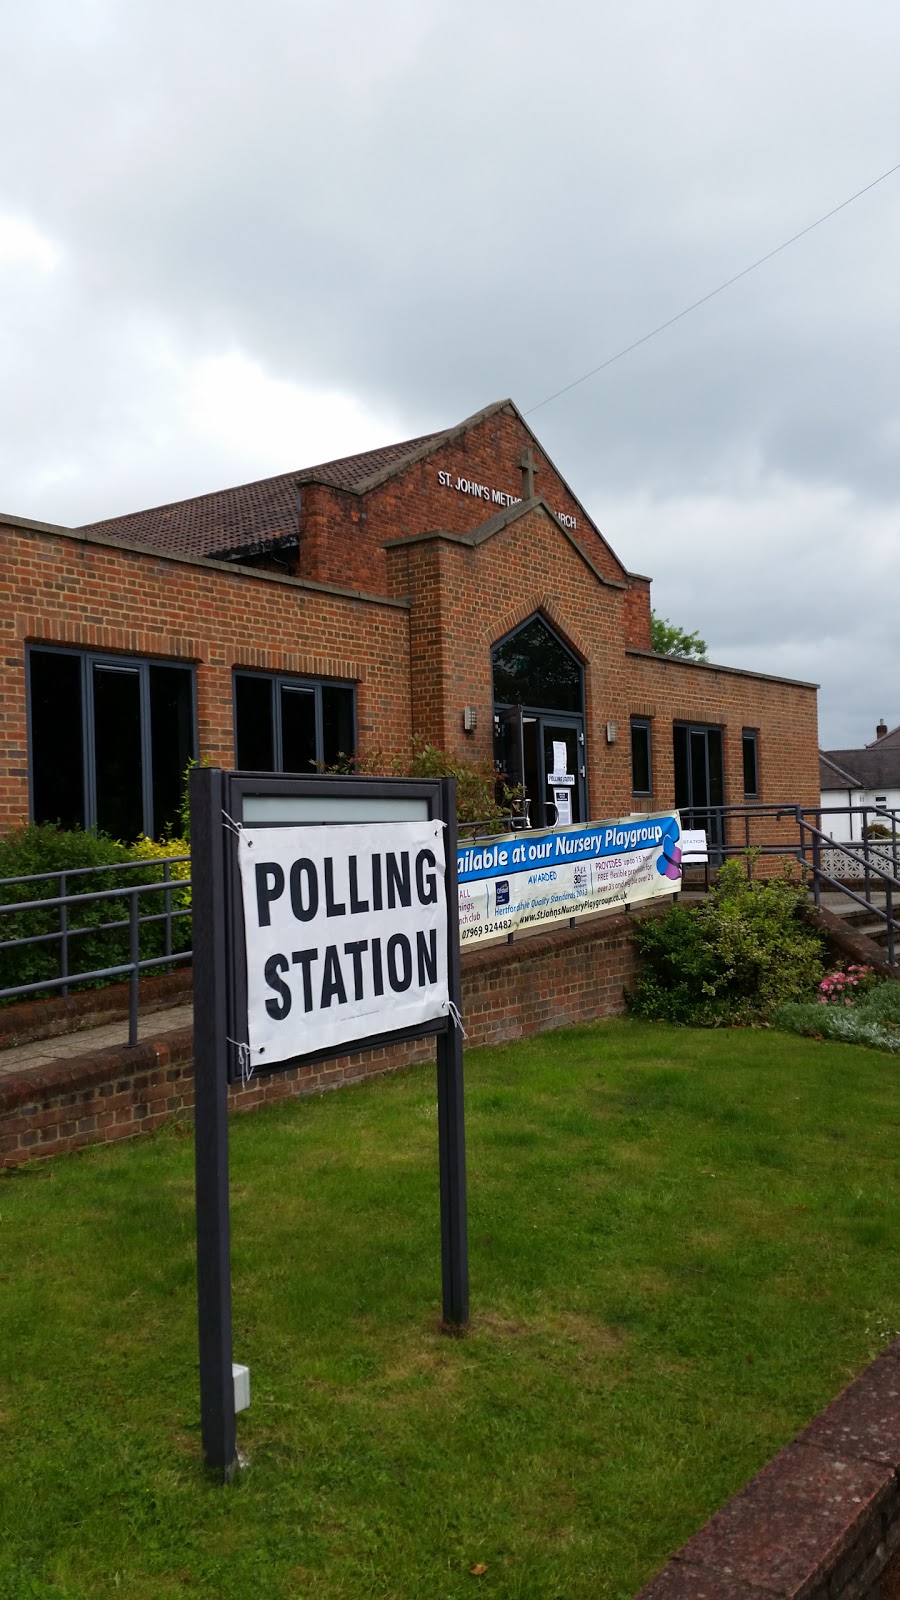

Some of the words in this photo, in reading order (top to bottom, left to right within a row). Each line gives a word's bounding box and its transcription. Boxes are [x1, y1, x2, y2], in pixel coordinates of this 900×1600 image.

[438, 470, 453, 488] ST.
[455, 477, 490, 500] JOHN'S
[512, 844, 526, 864] at
[528, 842, 552, 861] our
[555, 835, 602, 855] Nursery
[605, 825, 663, 850] Playgroup
[595, 858, 622, 871] PROVIDES
[527, 870, 557, 884] AWARDED
[598, 873, 609, 882] FREE
[255, 849, 438, 928] POLLING
[460, 889, 470, 899] ALL
[576, 888, 588, 898] 2013
[461, 925, 483, 940] 07969
[484, 918, 512, 935] 924482
[264, 928, 438, 1021] STATION
